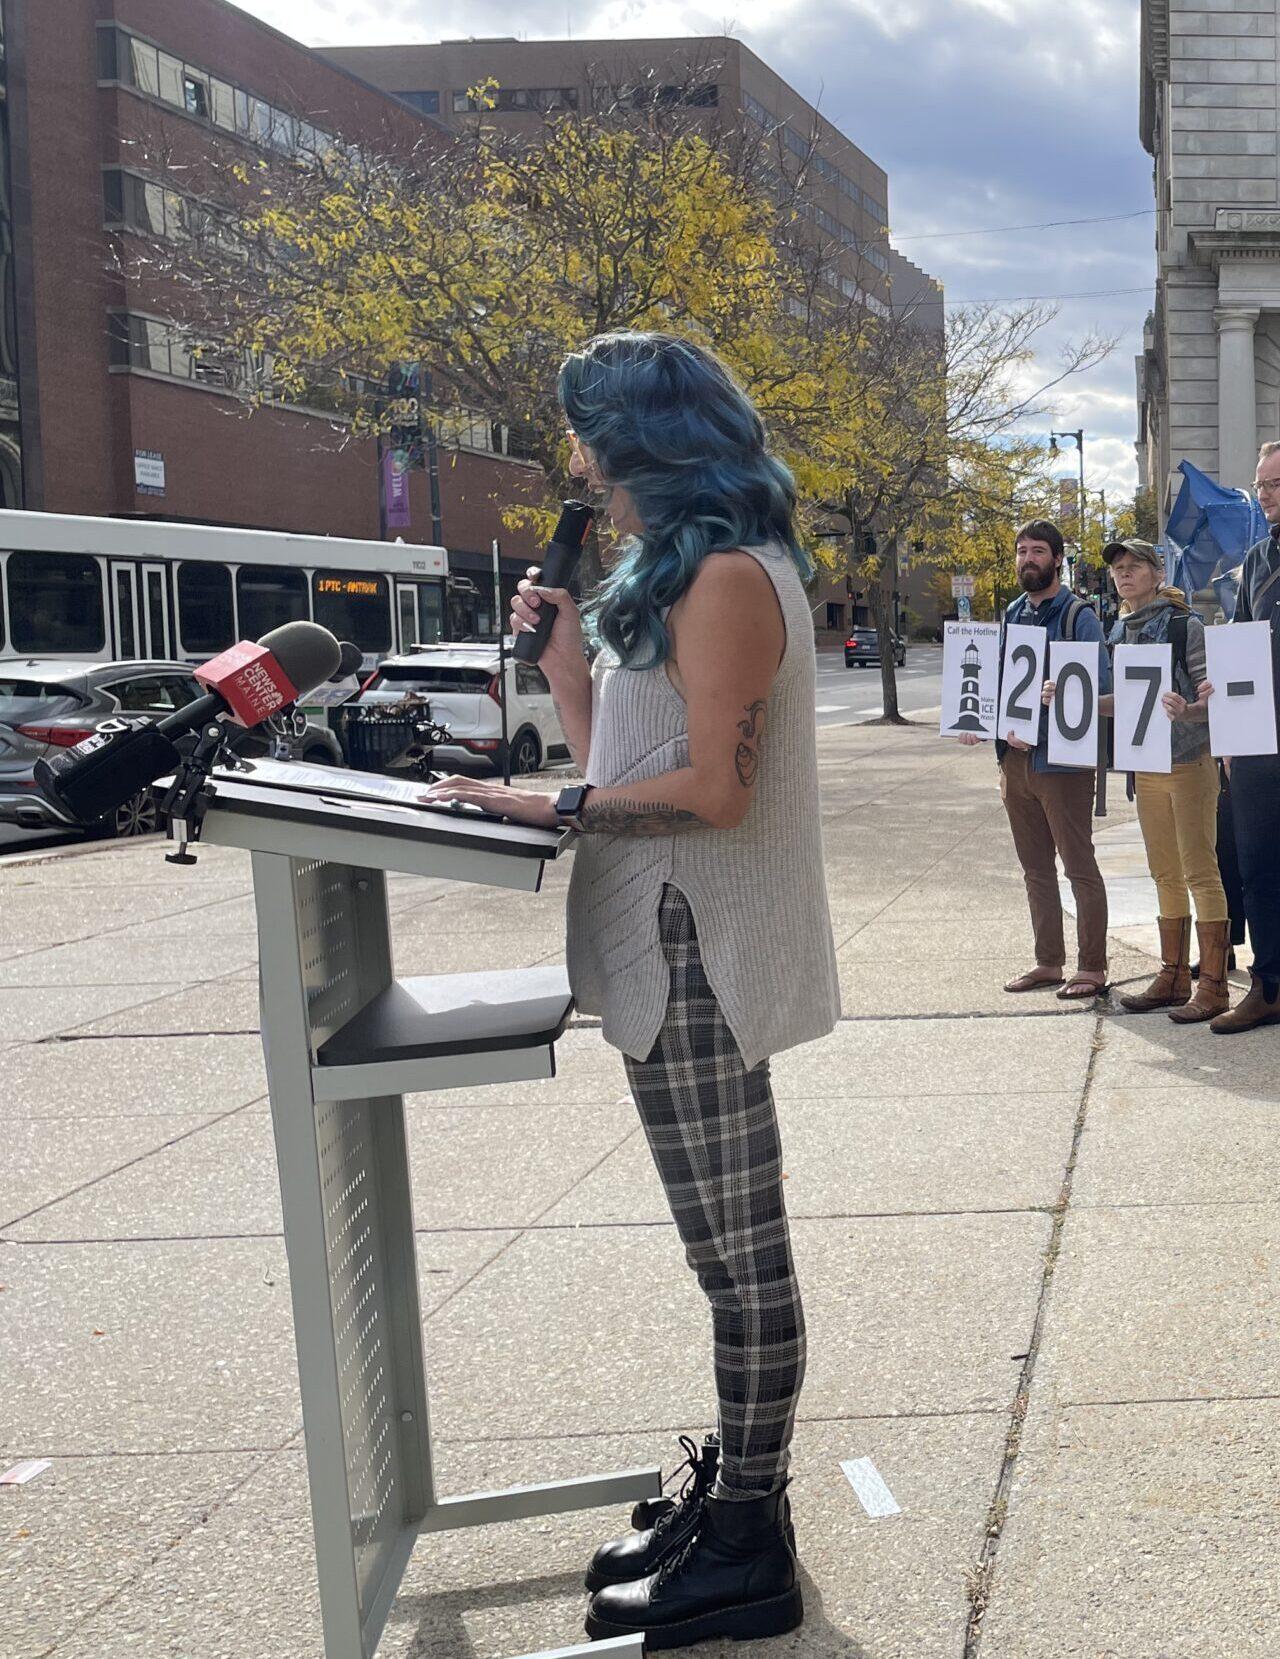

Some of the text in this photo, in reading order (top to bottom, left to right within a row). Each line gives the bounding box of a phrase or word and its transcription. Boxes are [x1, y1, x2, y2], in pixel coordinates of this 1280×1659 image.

[318, 580, 324, 592] 1
[947, 626, 998, 637] Call the Hotline
[244, 668, 277, 710] CENTER
[252, 662, 277, 694] NEWS
[234, 676, 267, 714] MAINE
[981, 704, 994, 713] ICE
[1006, 645, 1037, 721] 2
[1124, 666, 1162, 747] 7
